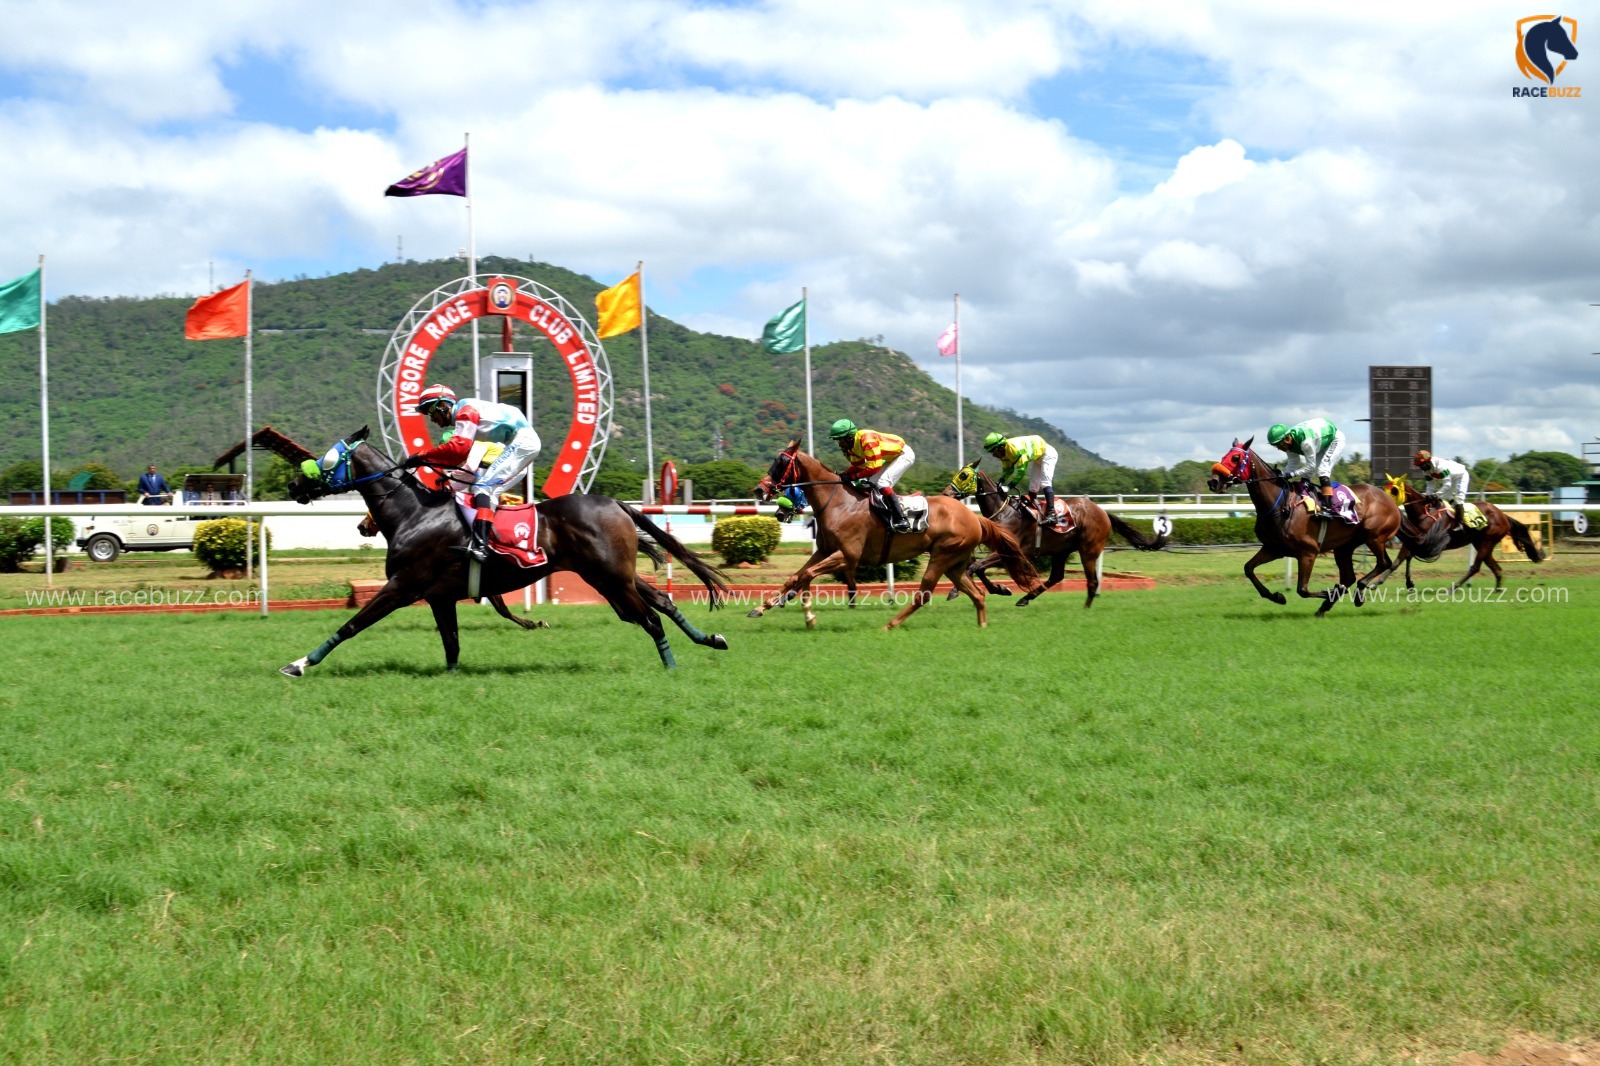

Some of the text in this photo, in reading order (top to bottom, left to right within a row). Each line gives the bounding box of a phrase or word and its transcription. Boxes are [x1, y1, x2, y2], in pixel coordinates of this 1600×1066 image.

[399, 299, 596, 425] MYSORE RACE CLUB LIMITED
[1158, 516, 1168, 535] 3
